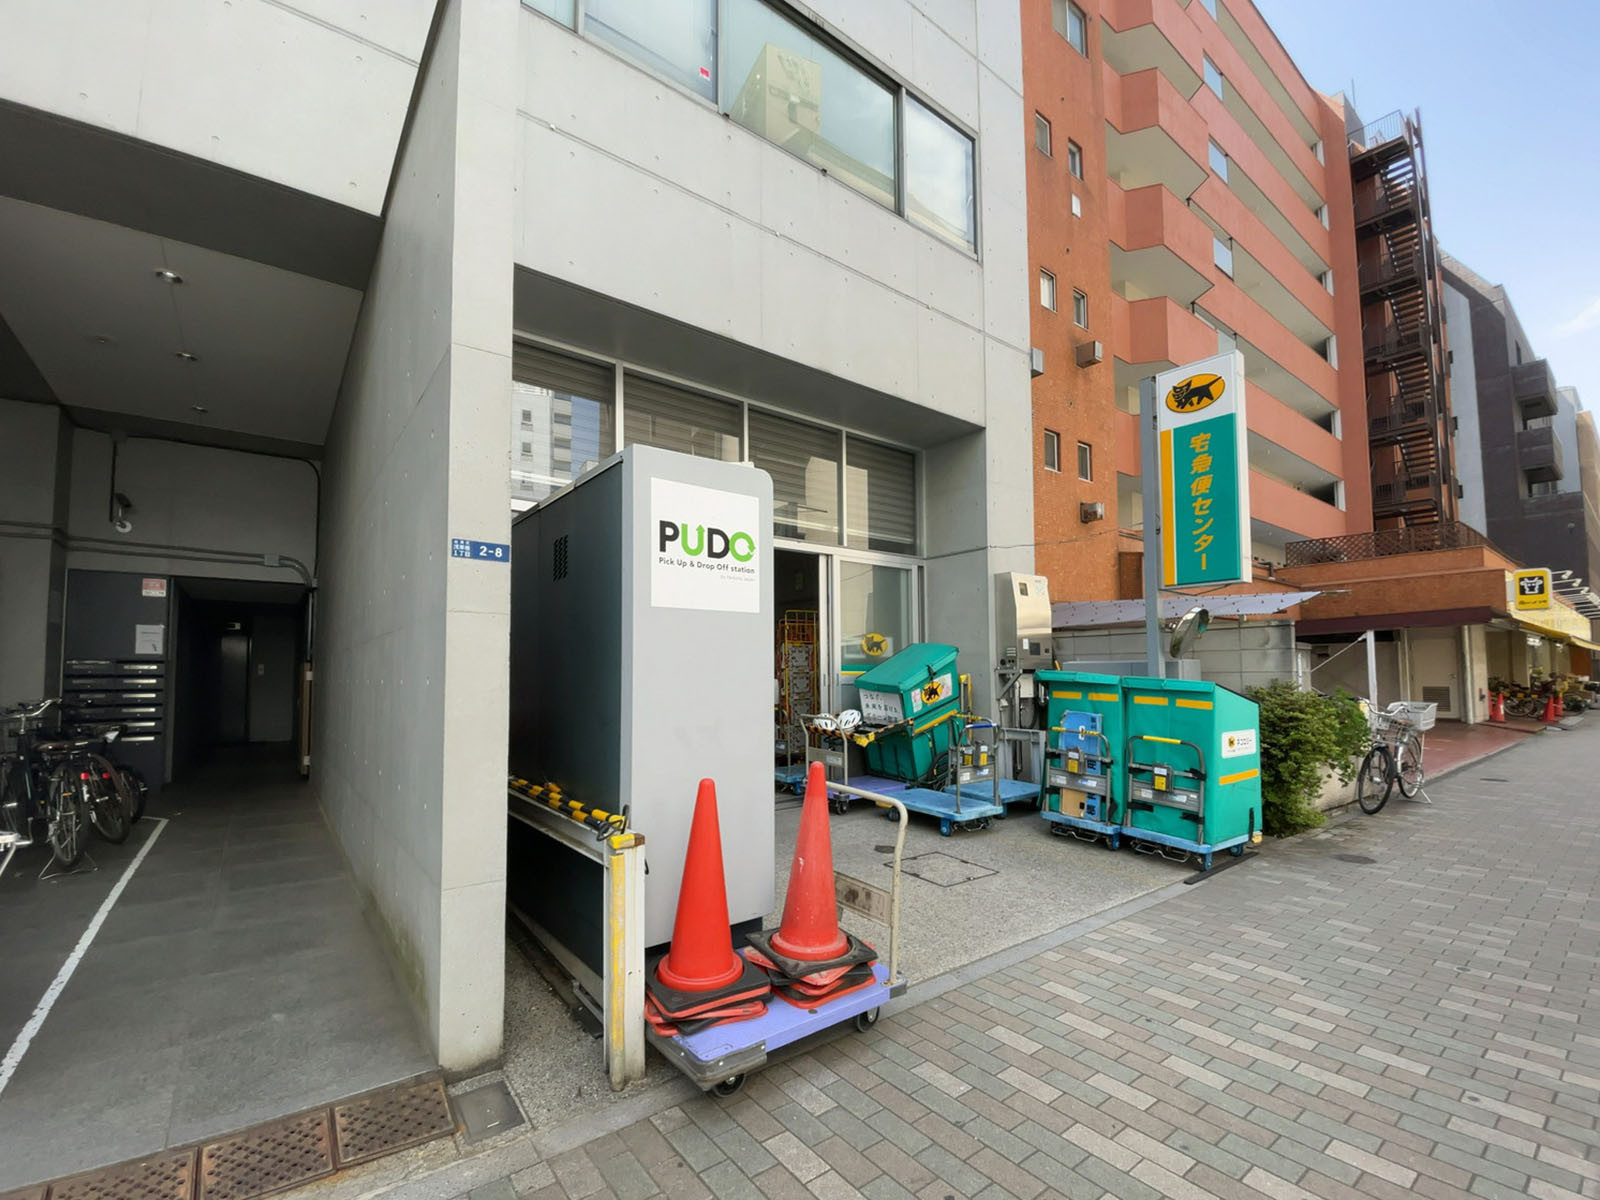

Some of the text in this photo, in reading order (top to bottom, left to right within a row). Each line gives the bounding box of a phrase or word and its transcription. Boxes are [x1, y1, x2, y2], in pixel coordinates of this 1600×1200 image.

[1189, 432, 1214, 571] 宅急便センター
[479, 545, 503, 558] 2-8
[659, 519, 756, 563] PUDO
[658, 556, 674, 565] Pick
[676, 559, 687, 568] Up
[697, 561, 715, 571] Drop
[716, 563, 729, 571] Off
[731, 565, 755, 574] station
